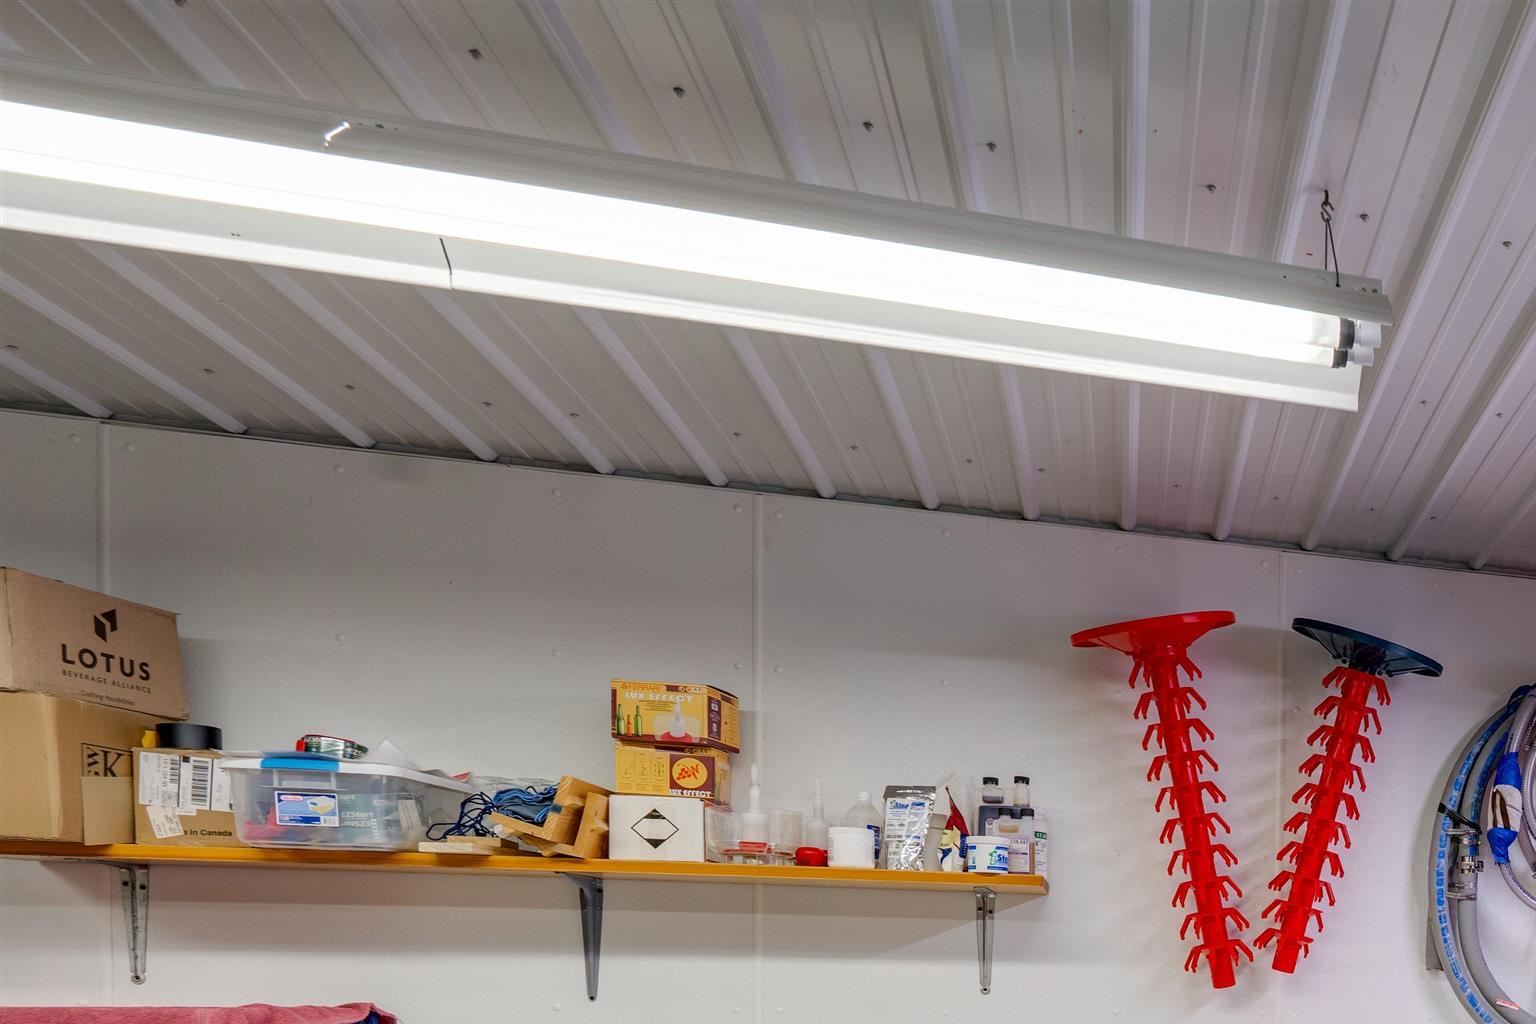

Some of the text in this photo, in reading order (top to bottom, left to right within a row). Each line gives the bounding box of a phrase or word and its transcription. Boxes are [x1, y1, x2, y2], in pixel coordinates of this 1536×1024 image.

[61, 643, 151, 681] LOTUS
[62, 669, 153, 694] BEVERAGE ALLIANCE
[648, 693, 694, 702] EFFECT
[189, 828, 199, 836] in
[200, 829, 233, 837] Canada
